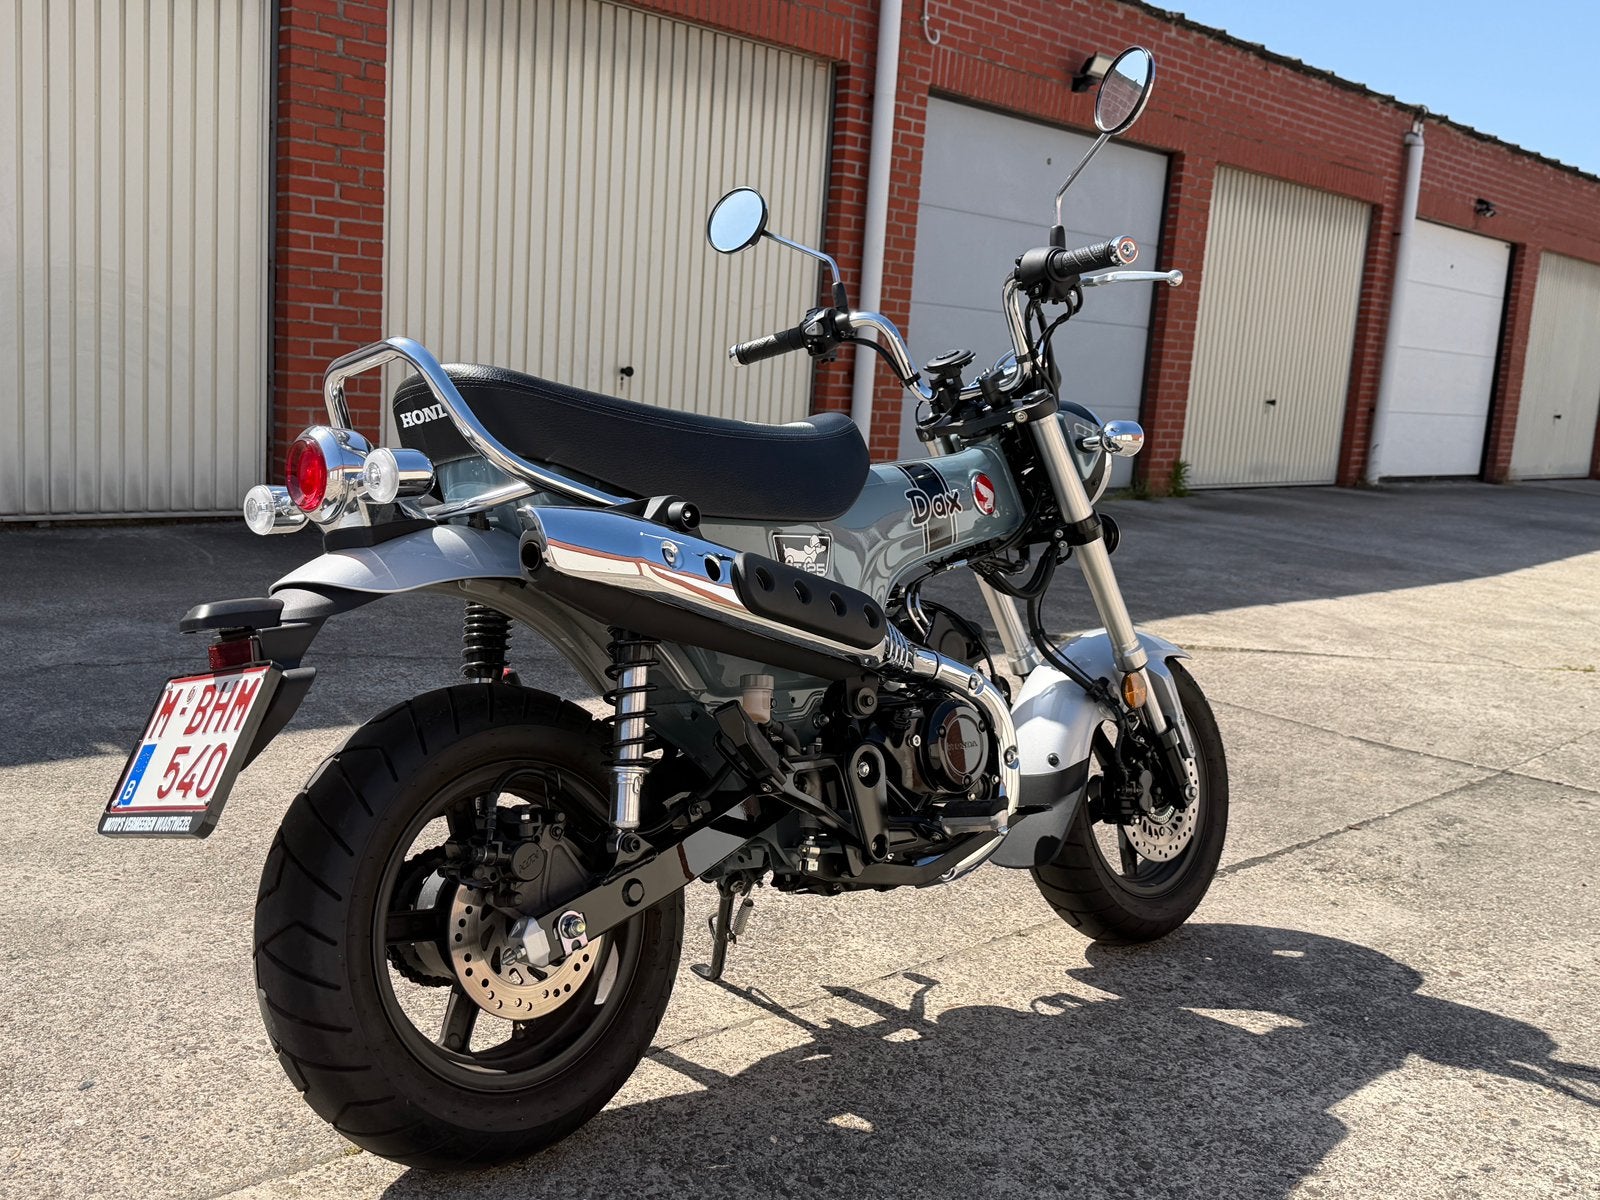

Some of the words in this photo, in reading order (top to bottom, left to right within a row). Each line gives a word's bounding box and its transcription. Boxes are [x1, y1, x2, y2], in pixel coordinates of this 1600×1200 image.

[904, 486, 963, 527] Dax
[122, 779, 137, 800] B
[157, 742, 228, 800] 540
